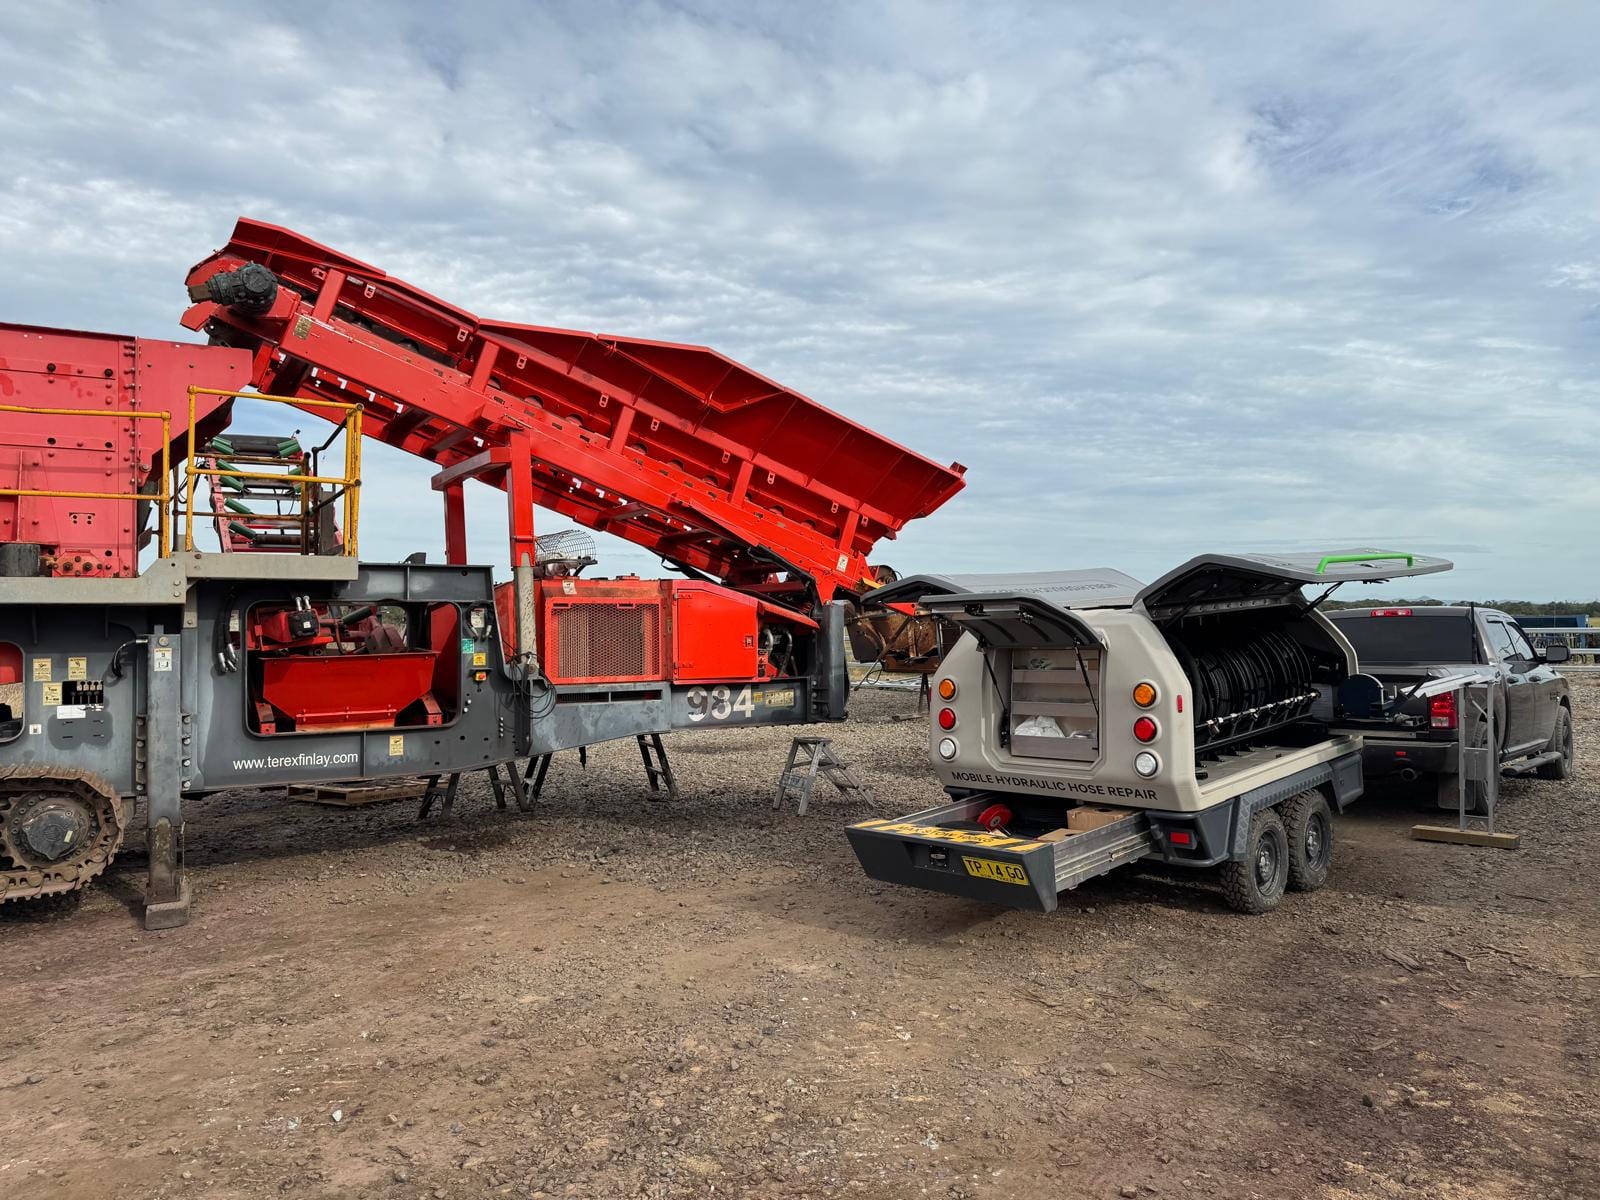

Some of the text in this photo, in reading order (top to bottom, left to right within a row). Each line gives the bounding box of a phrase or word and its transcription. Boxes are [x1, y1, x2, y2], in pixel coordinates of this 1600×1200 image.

[687, 684, 756, 722] 984
[232, 753, 359, 770] www.terexfinlay.com
[951, 771, 1159, 801] MOBILE HYDRAULIC HOSE REPAIR
